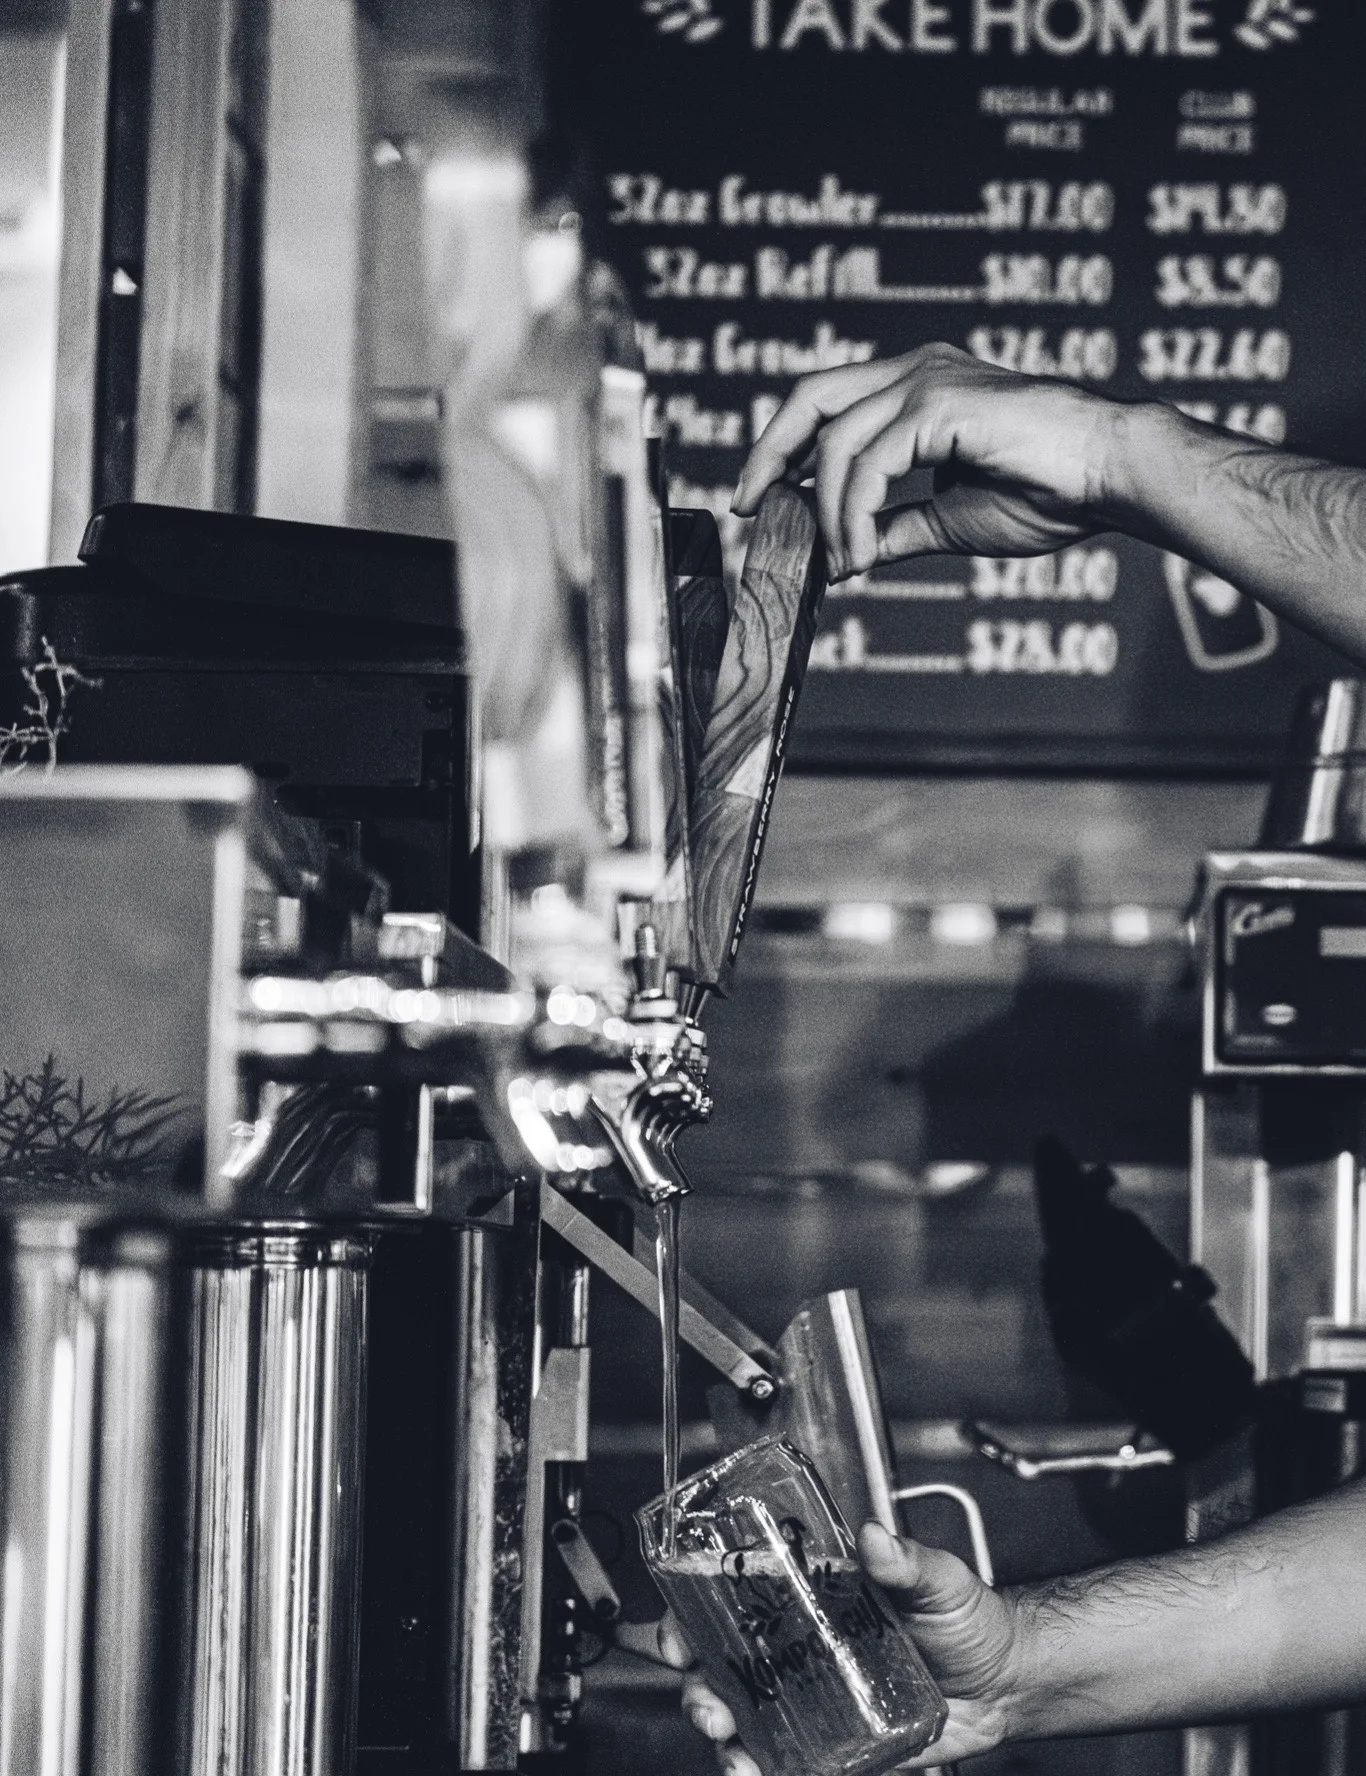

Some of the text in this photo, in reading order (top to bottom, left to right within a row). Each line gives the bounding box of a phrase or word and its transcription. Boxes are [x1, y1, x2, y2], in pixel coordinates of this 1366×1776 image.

[751, 0, 1220, 55] TAKE HOME
[1005, 119, 1085, 152] PRICE
[1176, 122, 1255, 155] PRICE
[718, 173, 880, 227] Growler
[729, 685, 796, 956] STRAWBERRY ROSE
